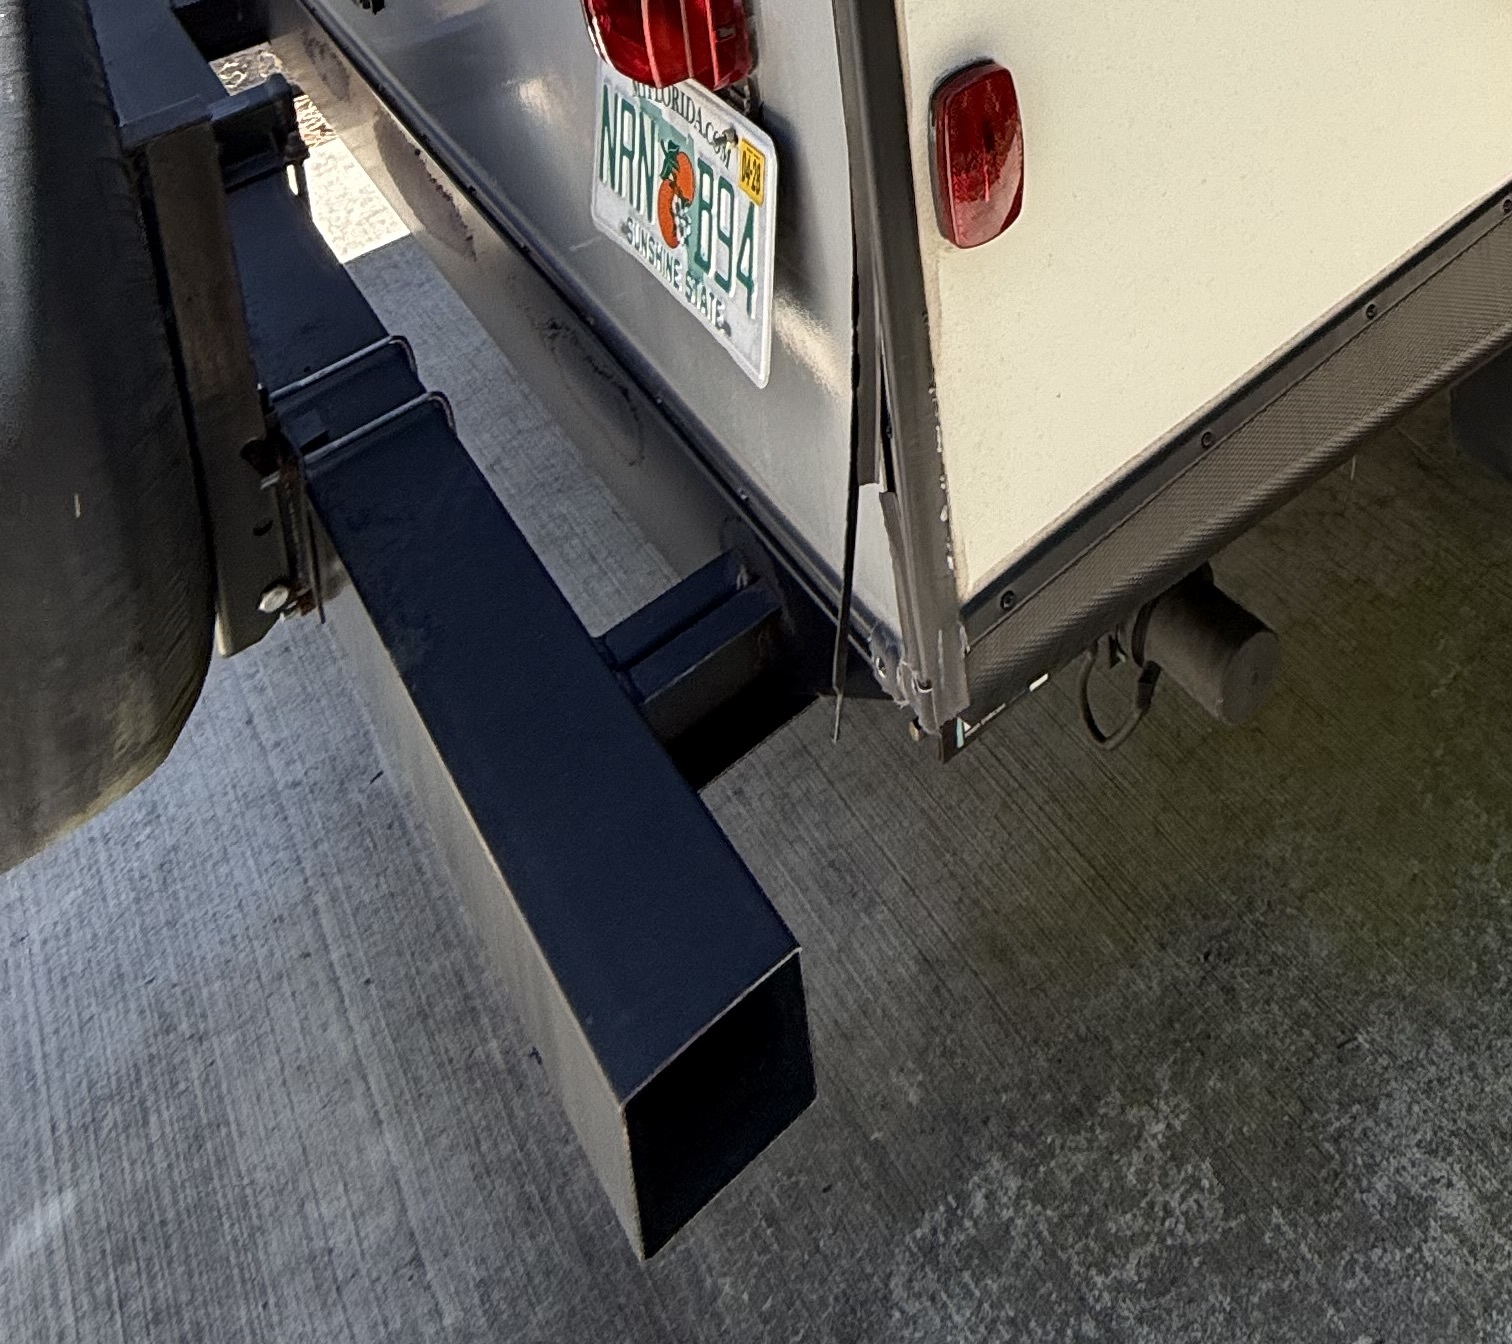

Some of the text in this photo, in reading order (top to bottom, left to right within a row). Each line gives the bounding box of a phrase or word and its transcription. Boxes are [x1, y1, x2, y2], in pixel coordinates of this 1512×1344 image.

[600, 83, 756, 320] NRN B94
[626, 216, 726, 329] SUNSHINE STATE
